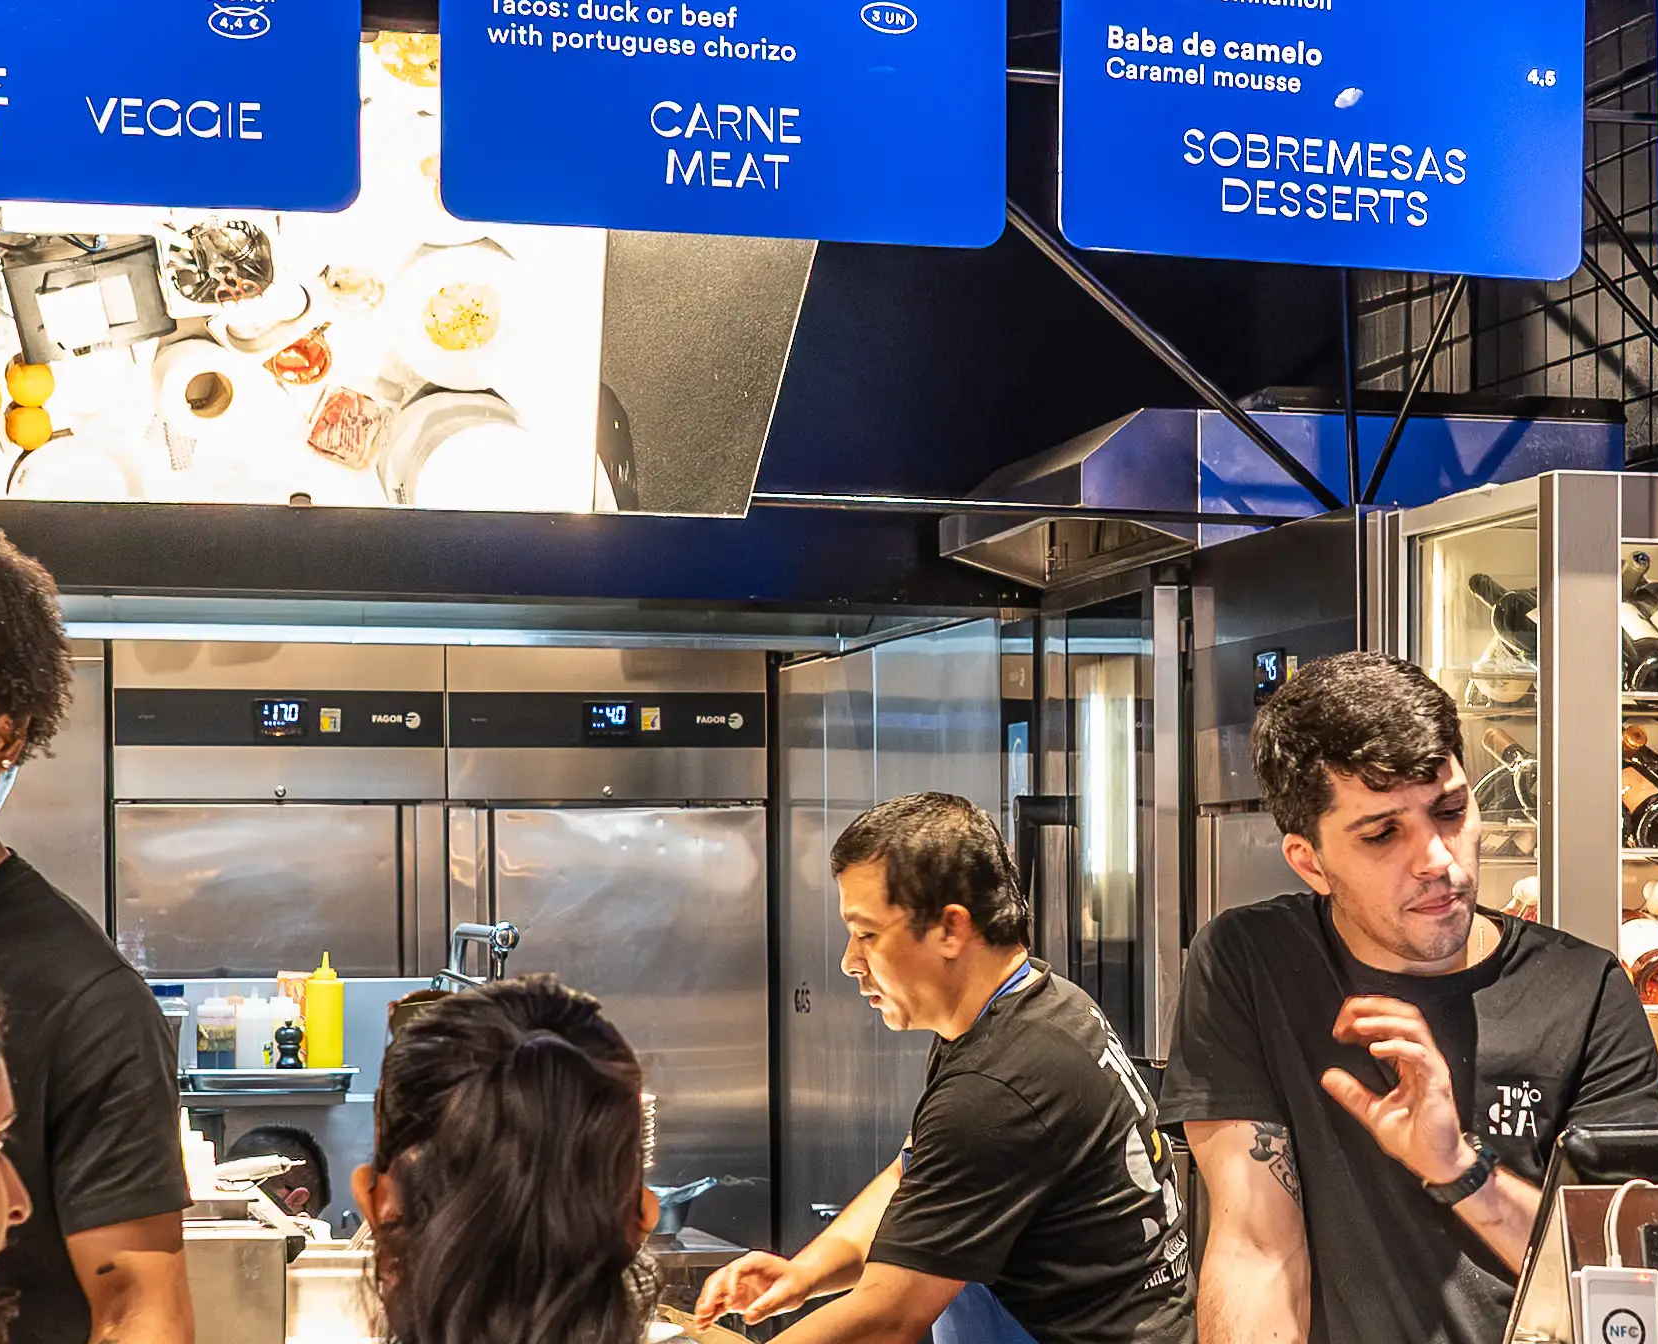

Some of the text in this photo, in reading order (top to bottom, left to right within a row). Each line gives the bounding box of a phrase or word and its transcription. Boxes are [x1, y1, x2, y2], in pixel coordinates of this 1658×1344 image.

[488, 23, 796, 61] with portuguese chorizo
[1108, 26, 1322, 66] Baba de camelo
[1107, 57, 1301, 93] Caramel mousse
[1528, 69, 1556, 87] 4,5
[86, 97, 262, 139] VEGGIE
[651, 101, 801, 143] CARNE
[666, 149, 789, 189] MEAT
[1184, 129, 1466, 184] SOBREMESAS
[1222, 178, 1428, 226] DESSERTS
[371, 714, 403, 724] FAGOR
[696, 715, 726, 724] FAGOR
[1609, 1324, 1639, 1338] NFC
